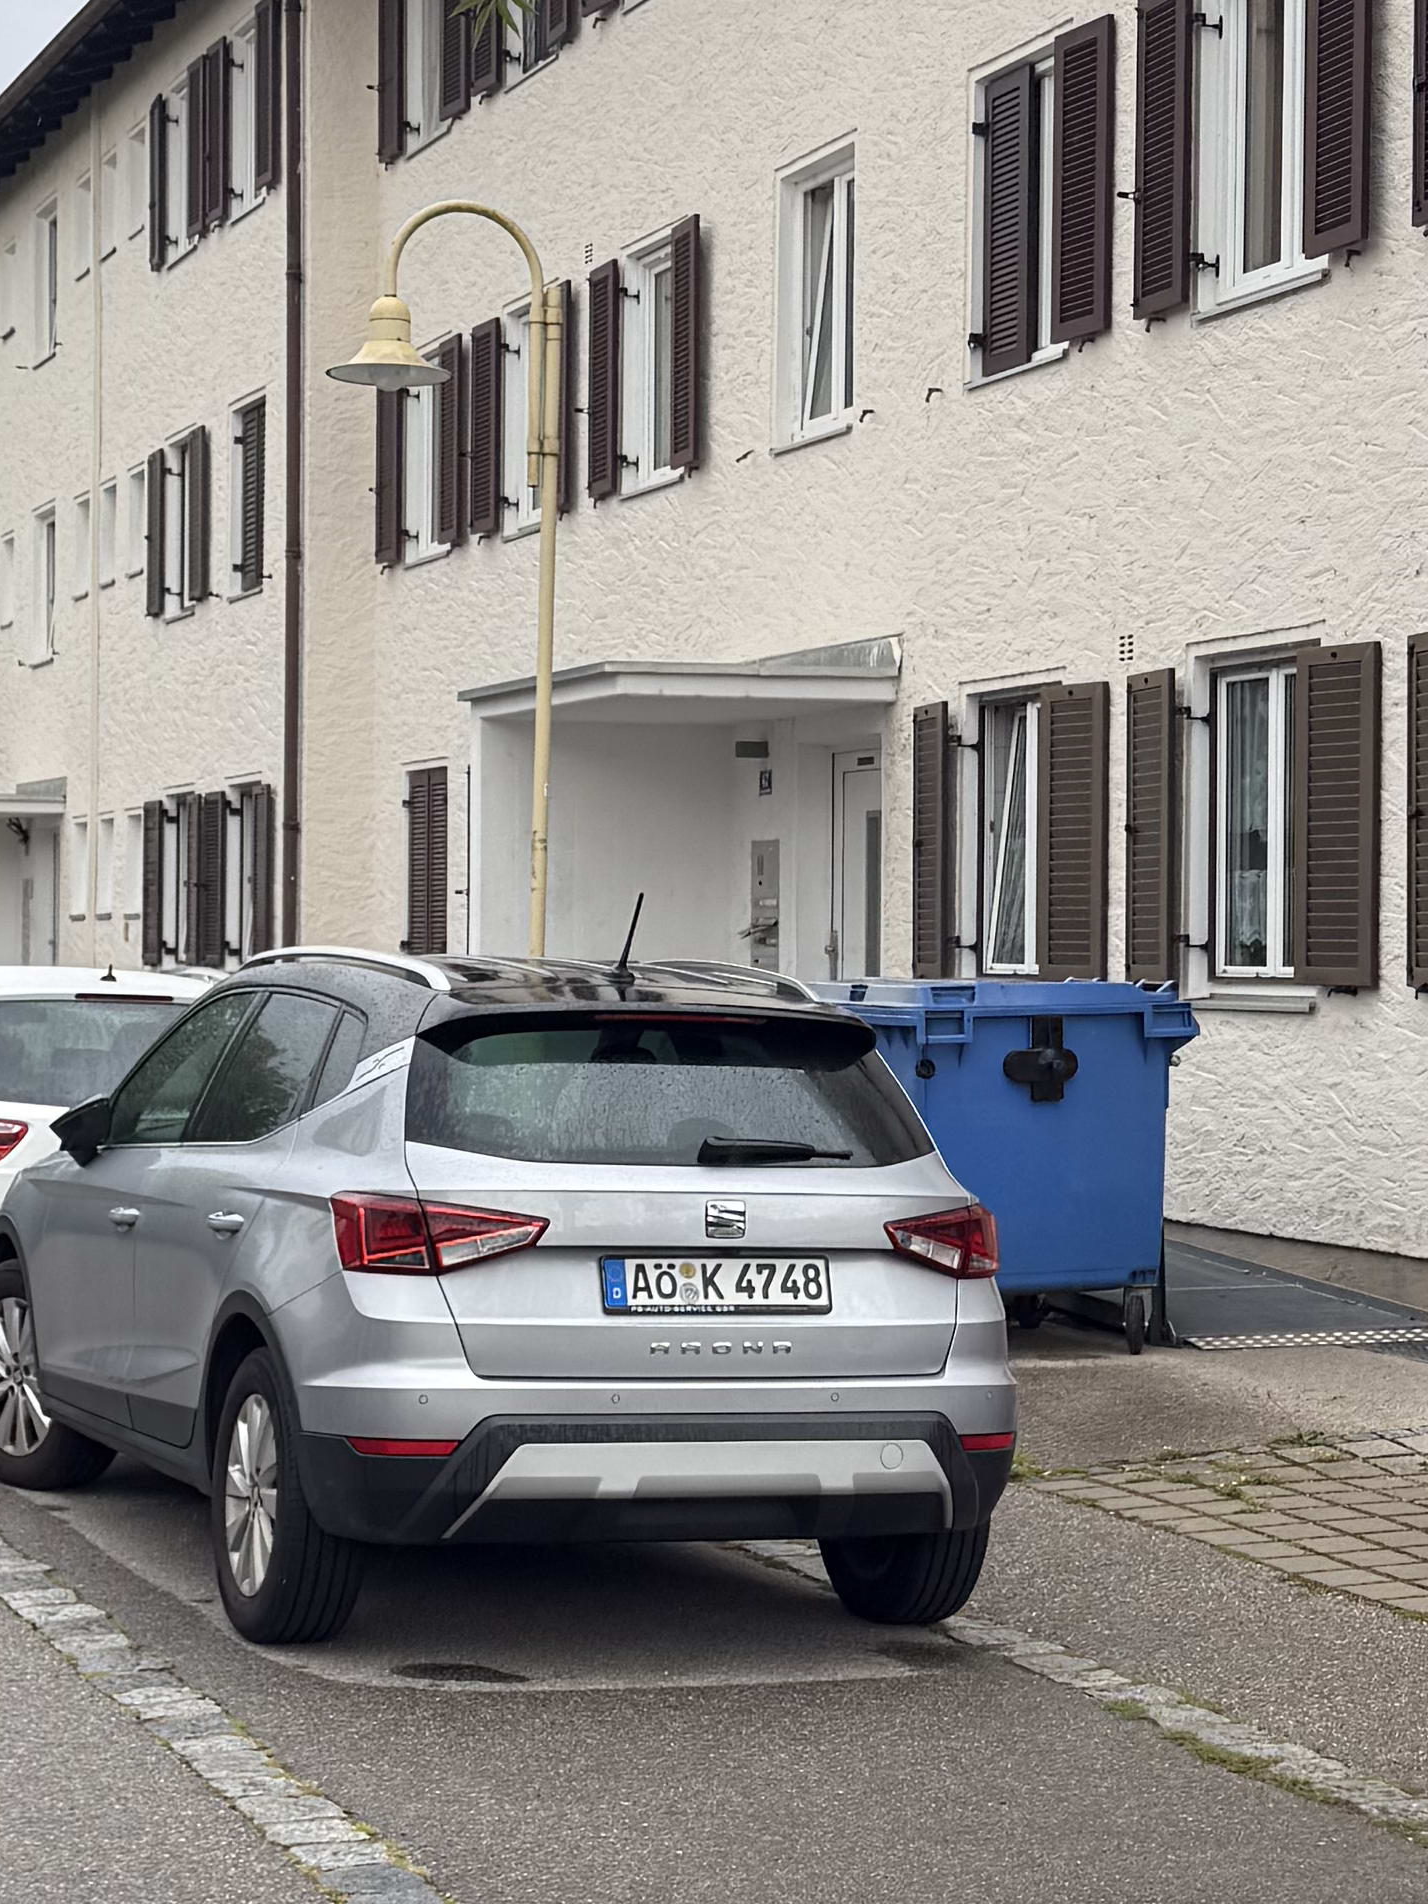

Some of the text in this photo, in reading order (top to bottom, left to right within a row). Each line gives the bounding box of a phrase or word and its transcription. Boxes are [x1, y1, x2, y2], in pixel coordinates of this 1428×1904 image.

[632, 1263, 823, 1300] AÖ K 4748
[649, 1341, 792, 1355] ARONA
